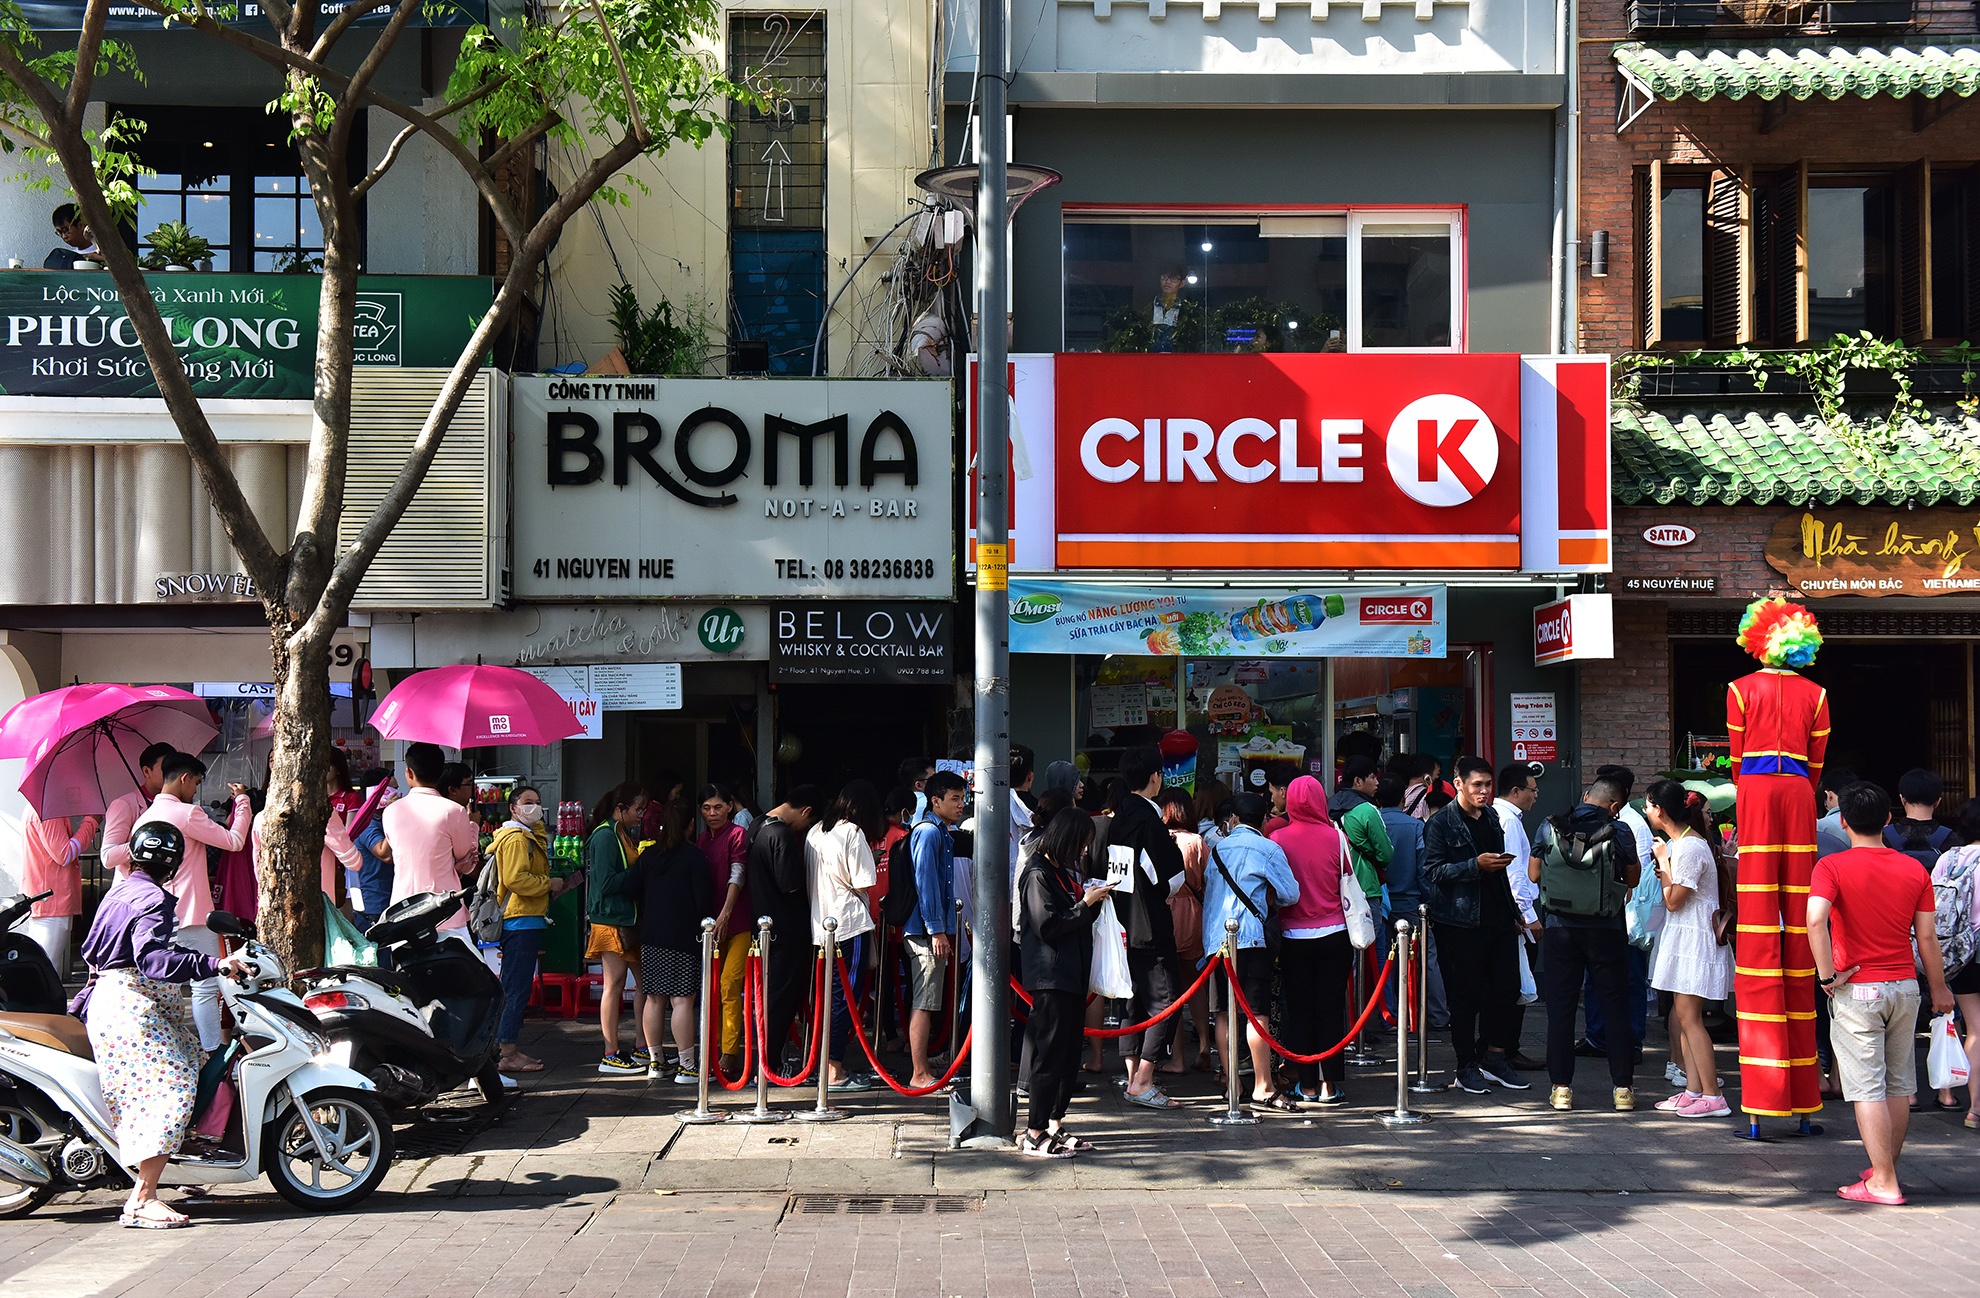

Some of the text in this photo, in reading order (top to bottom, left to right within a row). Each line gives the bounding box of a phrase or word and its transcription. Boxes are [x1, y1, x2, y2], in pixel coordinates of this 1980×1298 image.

[321, 3, 391, 14] Coff ea
[43, 285, 80, 303] Lộc
[173, 289, 223, 303] Xanh
[230, 288, 265, 304] Mới
[6, 305, 300, 350] PHÚC LONG
[32, 354, 275, 382] Khơi Sức ống Mới
[548, 379, 655, 400] CÔNG TY TNHH
[547, 407, 919, 507] BROMA
[1079, 417, 1365, 484] CIRCLE
[1649, 529, 1688, 542] SATRA
[533, 559, 934, 579] 41 NGUYEN HUE TEL: 08 38236838
[1627, 576, 1715, 592] 45 NGUYỄN HUỆ
[1801, 577, 1848, 590] CHUYÊN
[1850, 577, 1876, 589] MÓN
[1087, 605, 1118, 621] NĂNG
[1120, 599, 1156, 615] LƯỢNG
[1365, 604, 1408, 616] CIRCLE
[779, 611, 944, 640] BELOW
[1109, 619, 1126, 634] CÂY
[1126, 617, 1144, 631] BẠC
[1145, 614, 1158, 626] HÀ
[1537, 618, 1561, 644] CIRCLE
[520, 608, 627, 662] matcha
[779, 643, 944, 657] WHISKY & COCKTAIL BAR
[579, 698, 597, 716] CÂY
